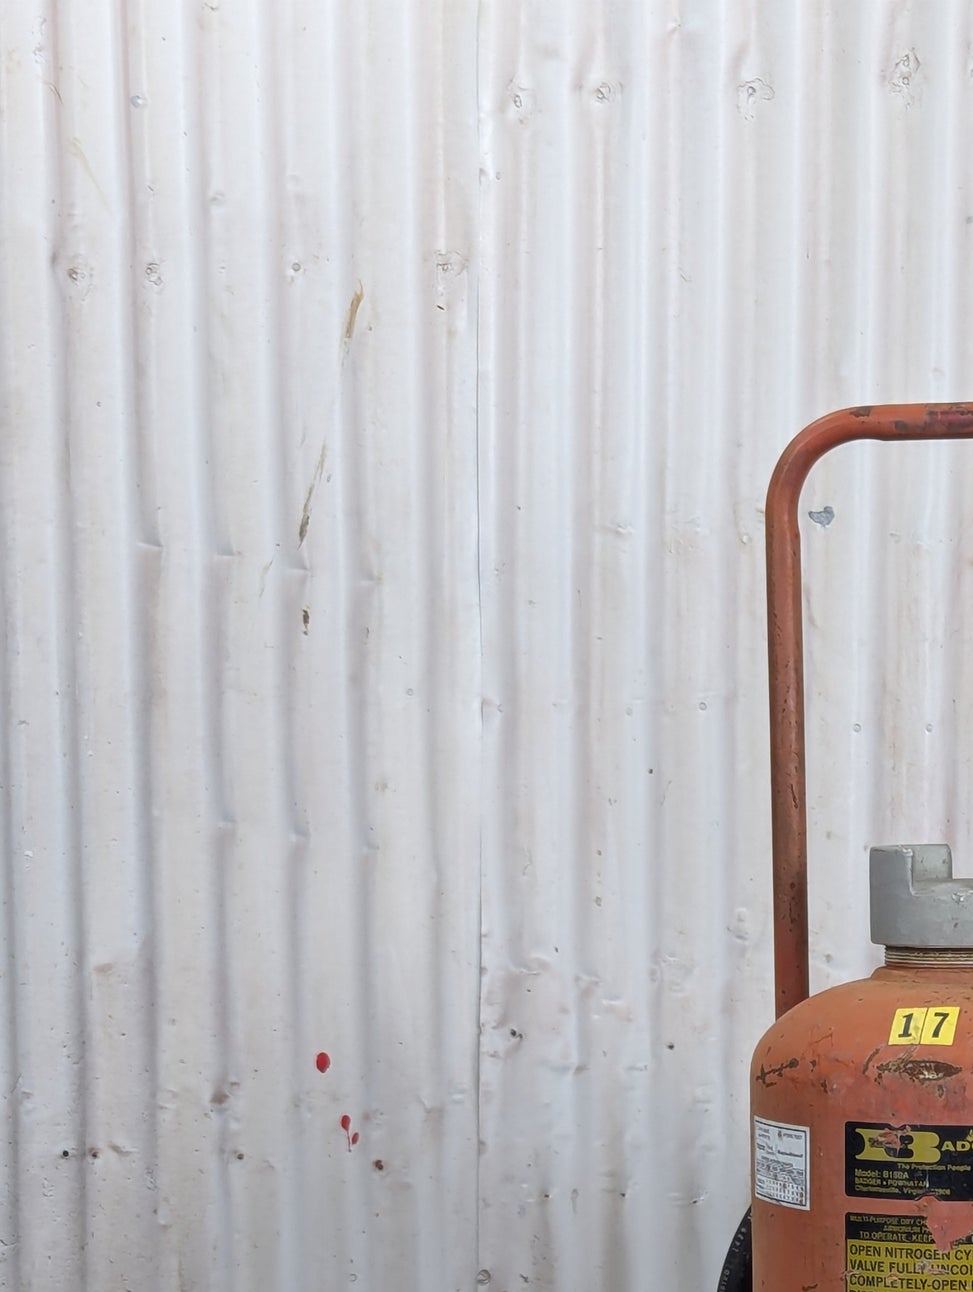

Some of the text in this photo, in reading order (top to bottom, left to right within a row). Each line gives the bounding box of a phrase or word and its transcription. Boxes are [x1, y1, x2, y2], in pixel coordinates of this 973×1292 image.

[850, 1244, 881, 1257] OPEN
[885, 1246, 950, 1260] NITROGEN
[850, 1259, 884, 1272] VALVE
